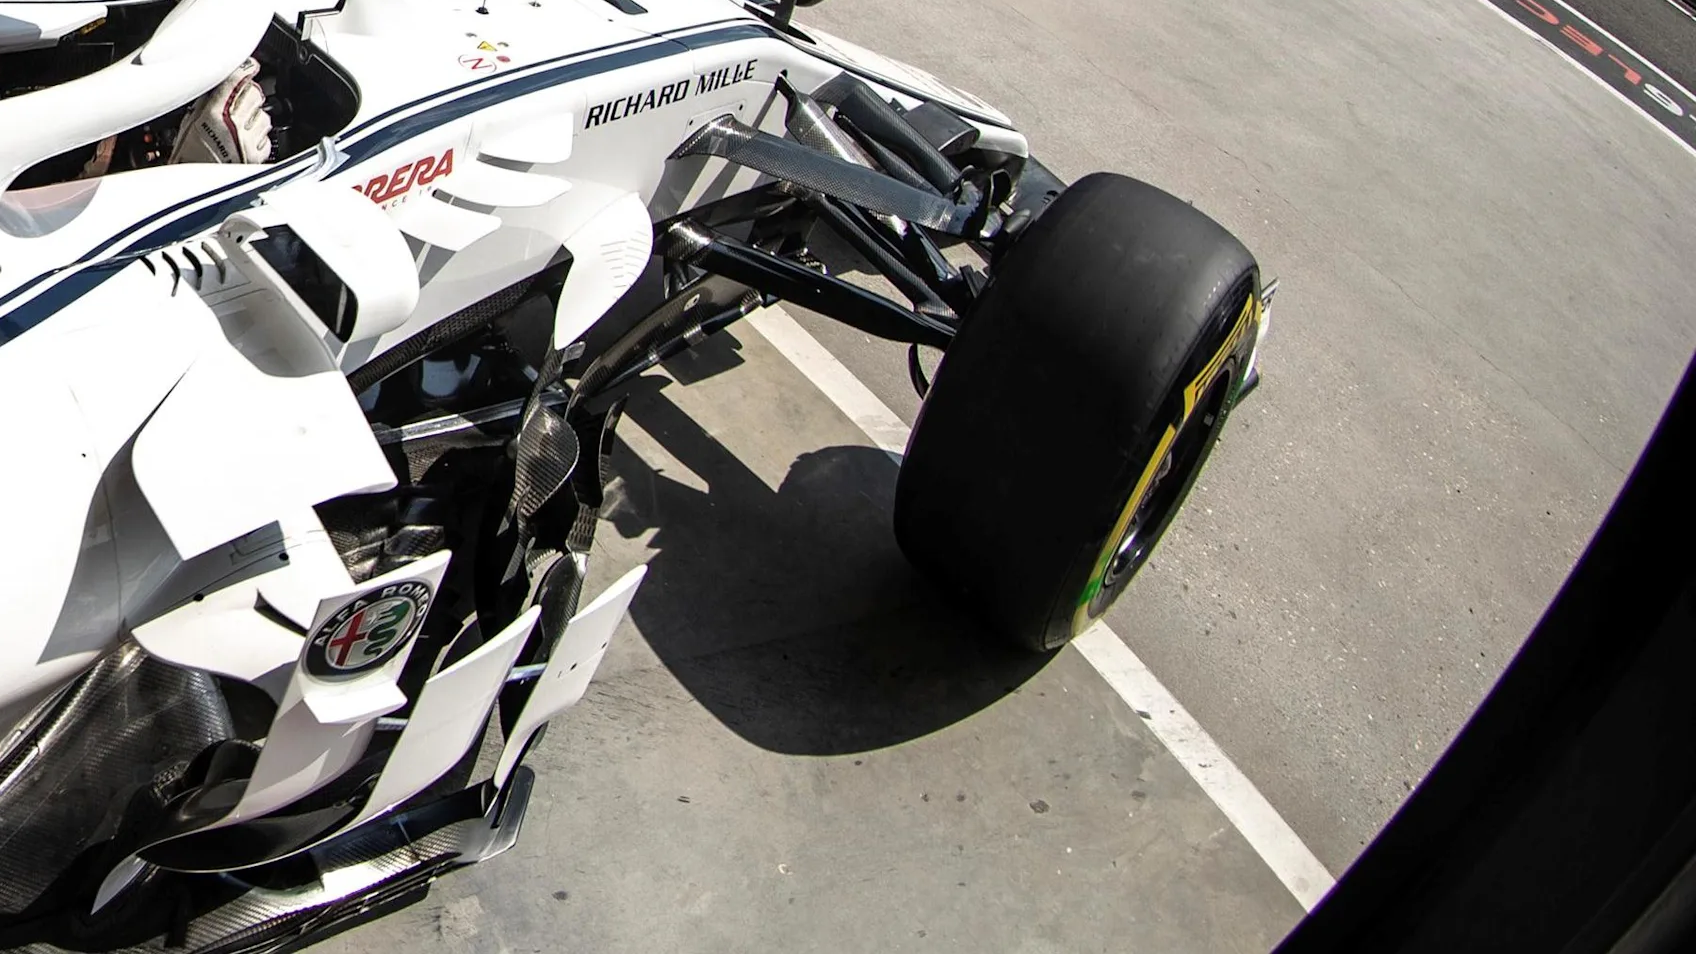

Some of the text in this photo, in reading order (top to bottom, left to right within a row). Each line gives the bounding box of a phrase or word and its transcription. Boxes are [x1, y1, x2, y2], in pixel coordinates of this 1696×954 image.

[584, 59, 758, 130] RICHARD MILLE
[200, 122, 229, 158] RICHARD
[351, 148, 454, 205] RERA
[314, 583, 428, 647] ALFA ROMEO
